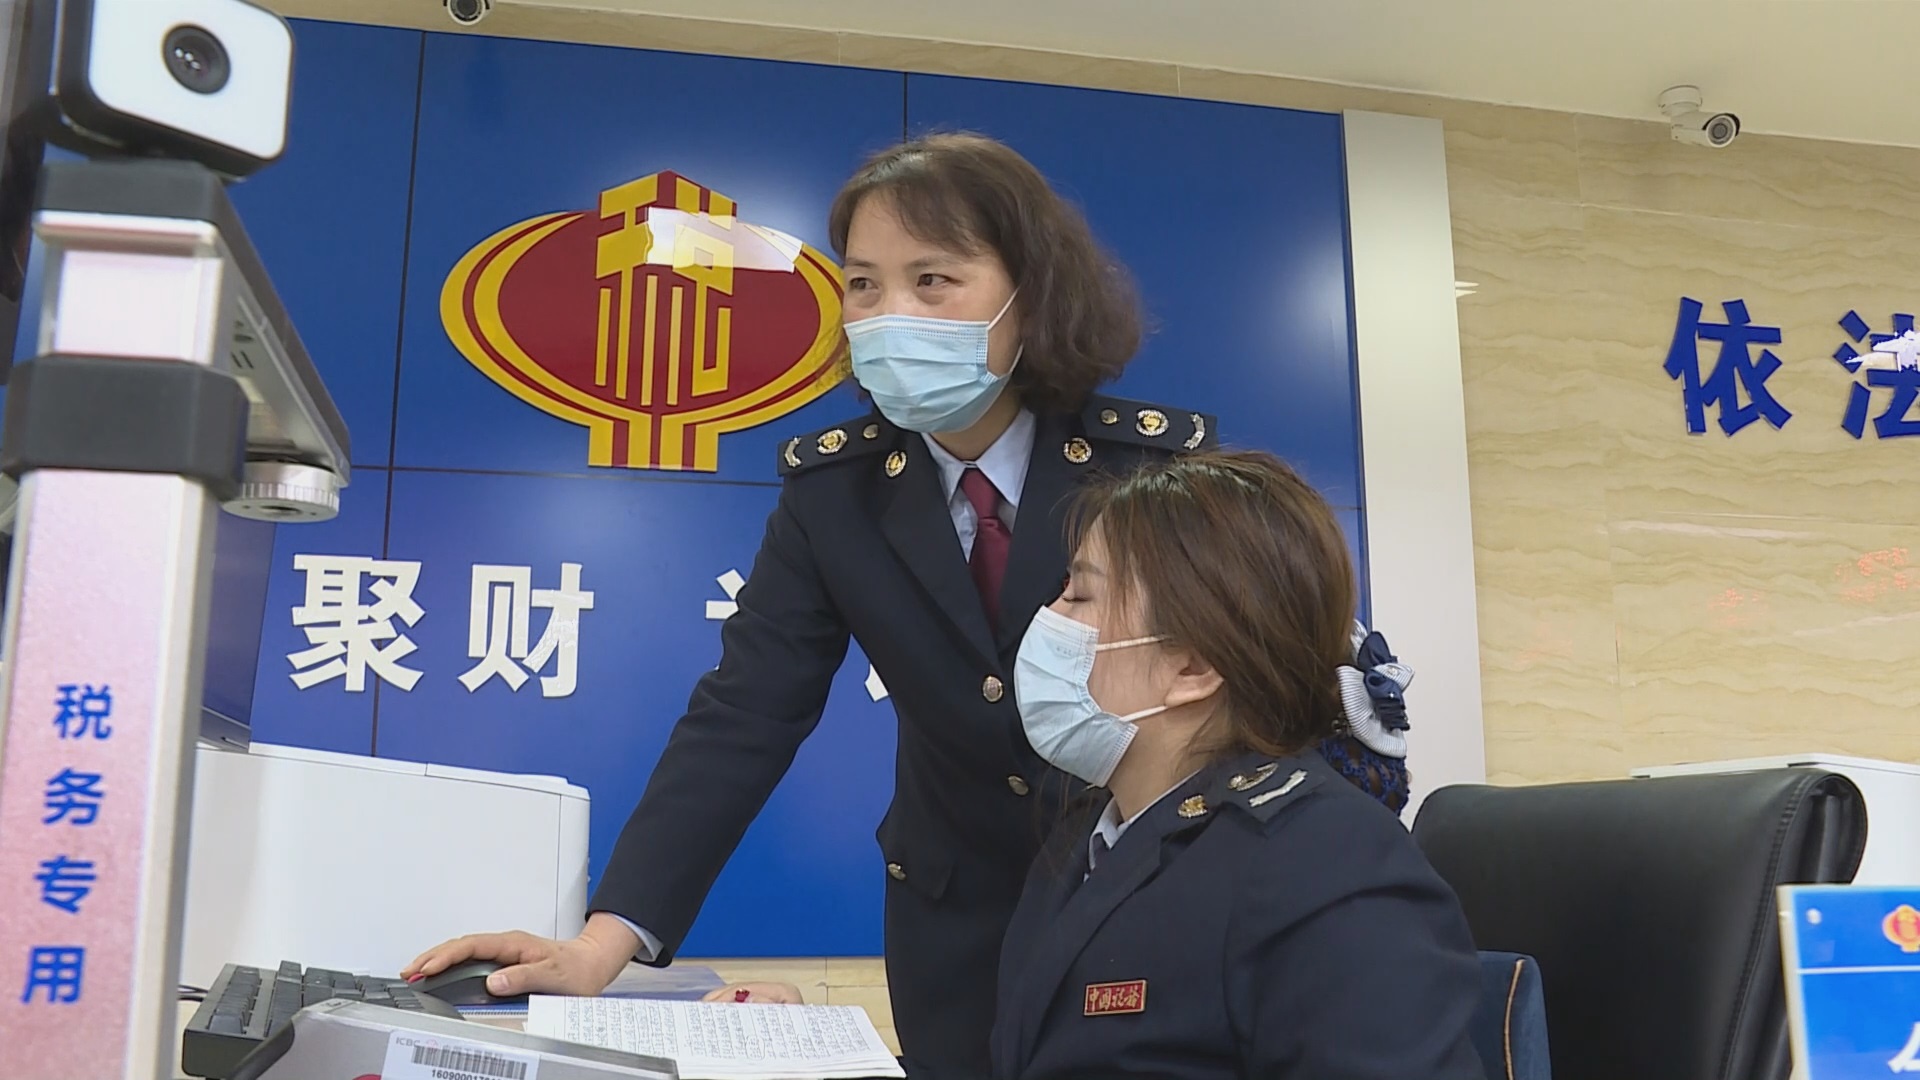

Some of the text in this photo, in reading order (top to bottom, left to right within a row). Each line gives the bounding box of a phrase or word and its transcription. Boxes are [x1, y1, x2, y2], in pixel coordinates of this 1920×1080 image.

[1662, 296, 1920, 440] 依法
[286, 553, 595, 699] 聚财
[20, 684, 114, 1005] 税务专用
[395, 1036, 421, 1048] ICBC
